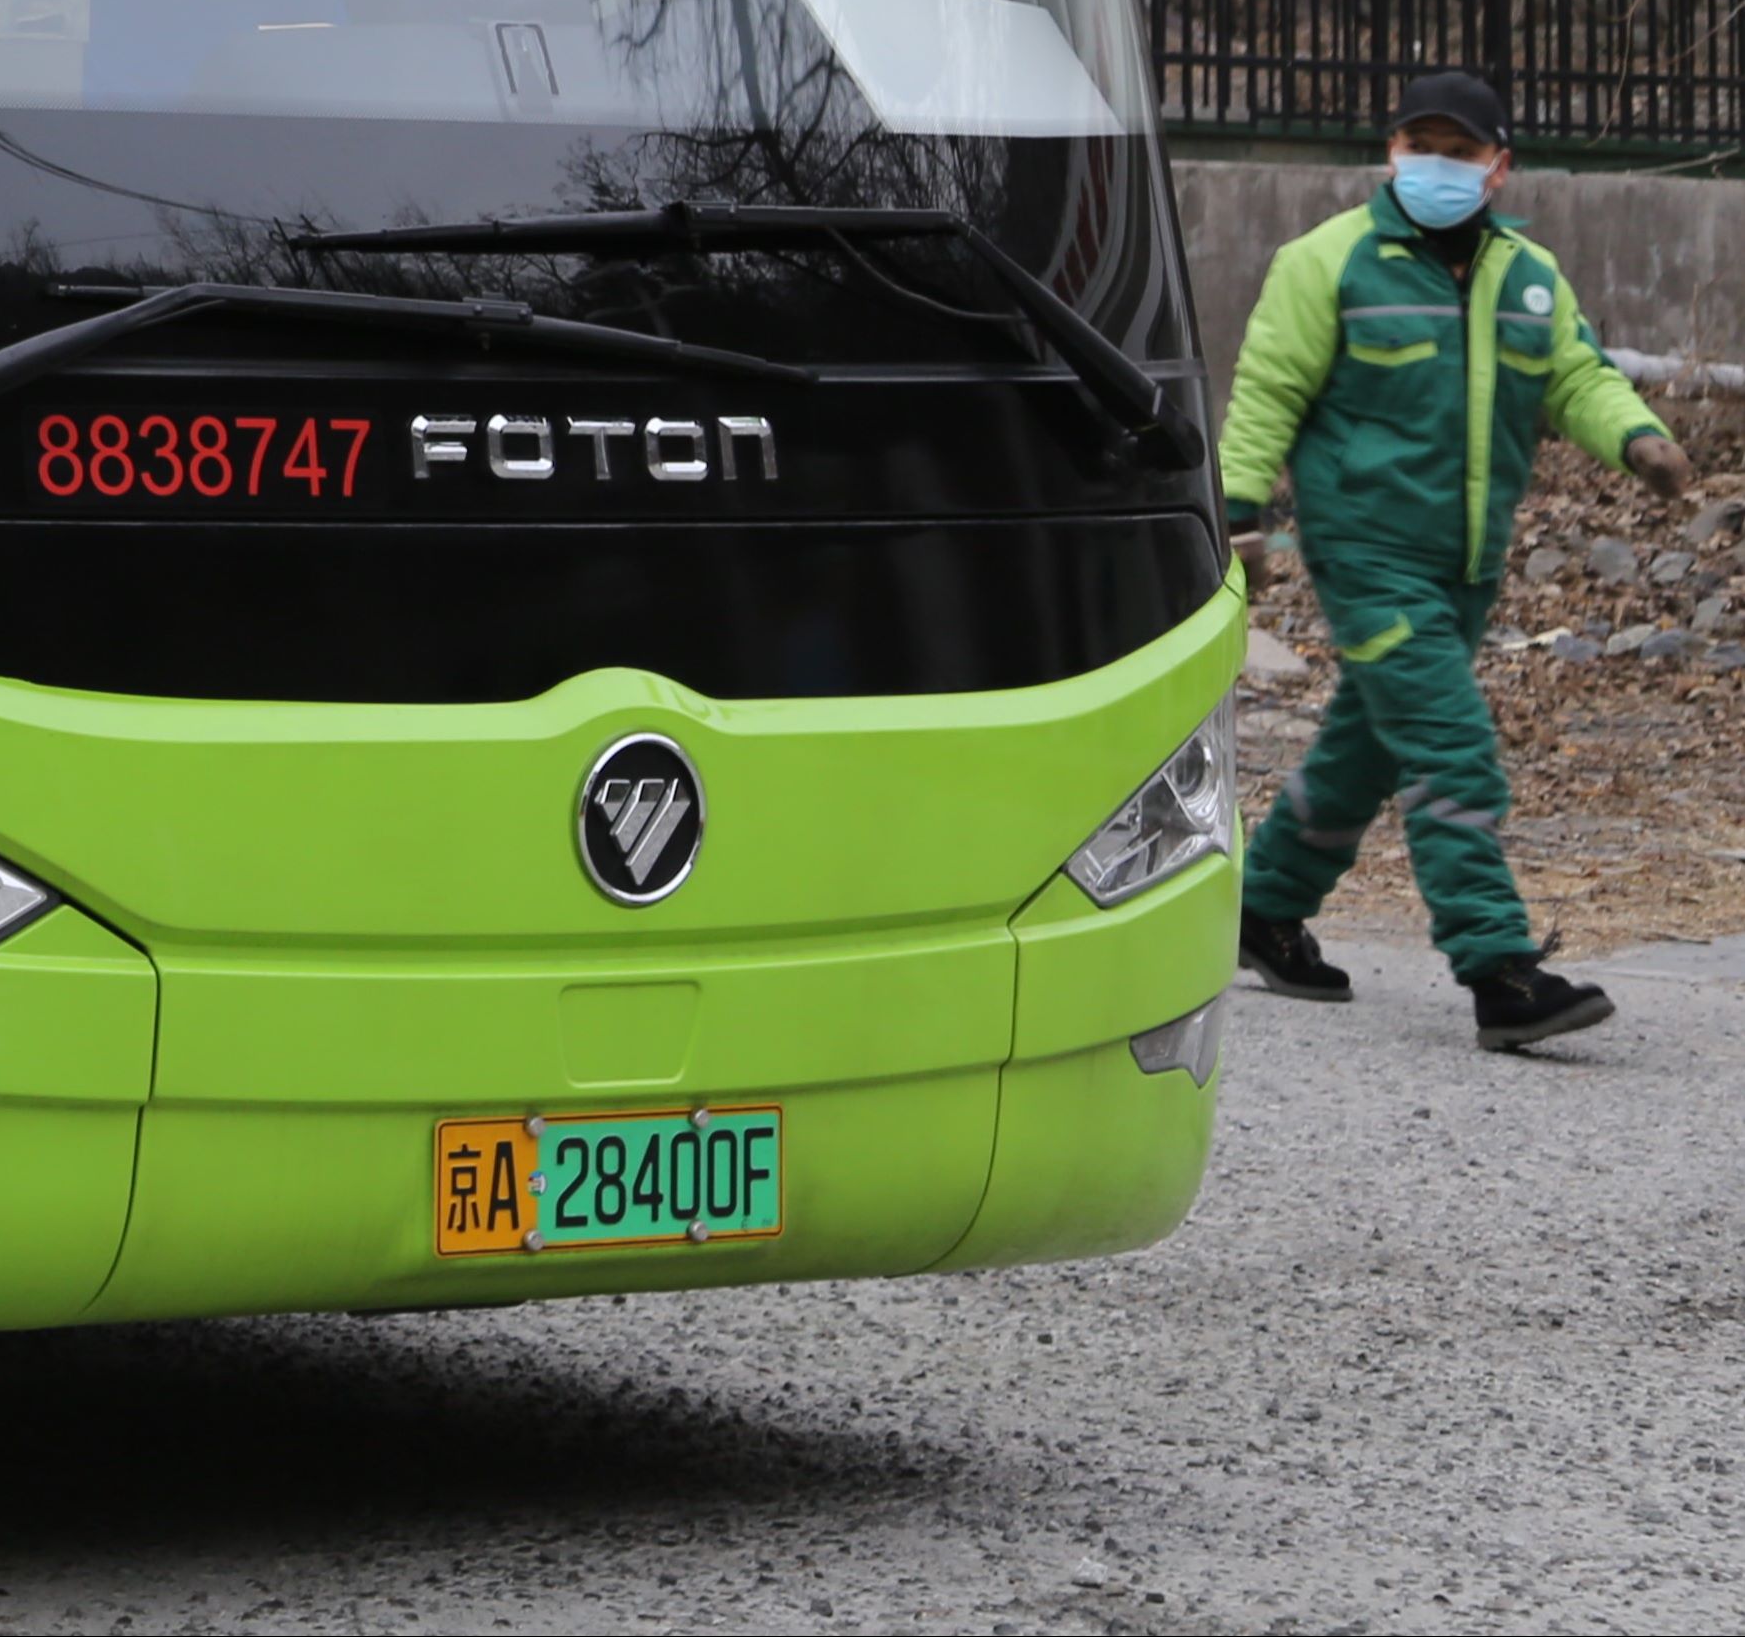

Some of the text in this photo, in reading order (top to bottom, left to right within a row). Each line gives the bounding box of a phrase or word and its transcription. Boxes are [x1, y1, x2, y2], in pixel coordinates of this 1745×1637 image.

[38, 414, 778, 497] 8838747 FOTON
[446, 1126, 774, 1233] 京A 28400F
